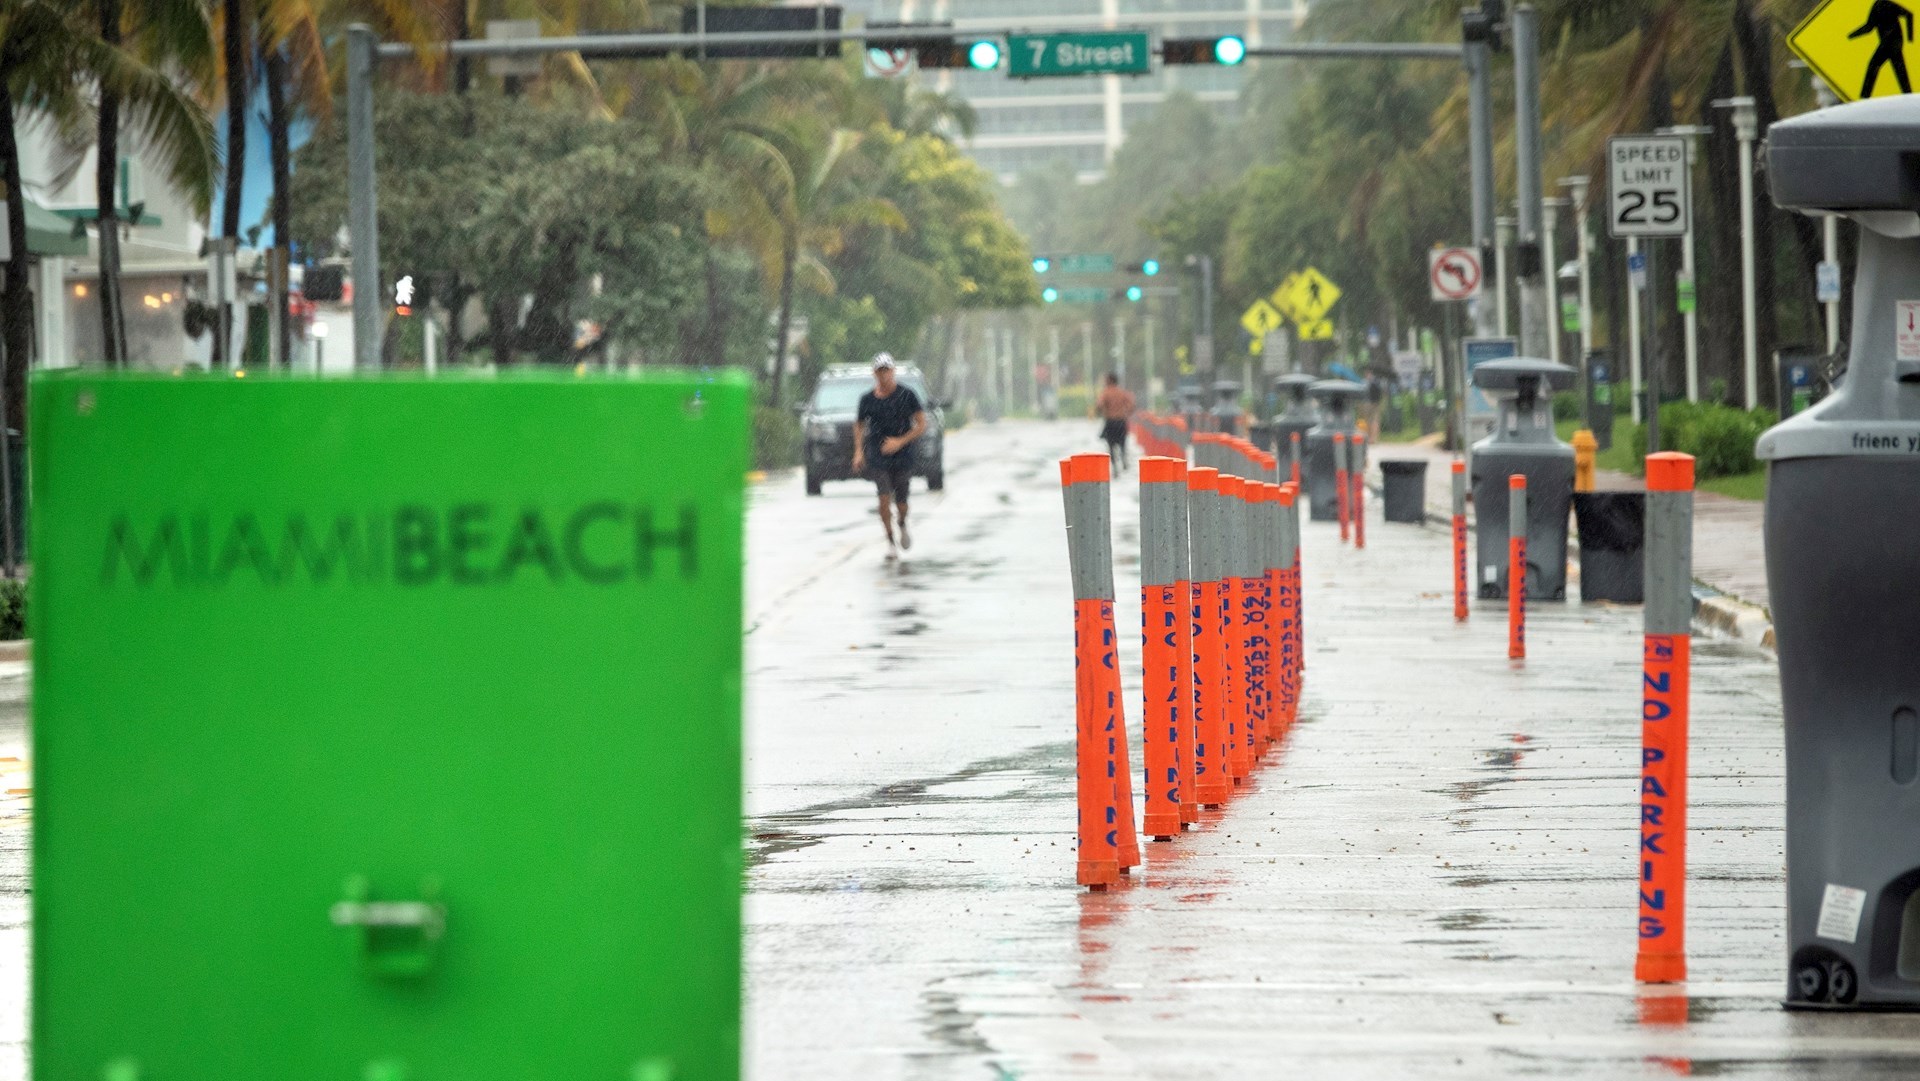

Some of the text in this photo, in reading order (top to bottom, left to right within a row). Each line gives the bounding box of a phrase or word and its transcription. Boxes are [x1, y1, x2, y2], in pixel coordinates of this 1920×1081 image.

[1026, 40, 1133, 68] 7 Street
[1615, 145, 1681, 163] SPEED
[1622, 167, 1673, 184] LIMIT
[1617, 189, 1680, 223] 25
[1250, 636, 1266, 720] PARKIN
[1638, 671, 1671, 938] NO PARKING
